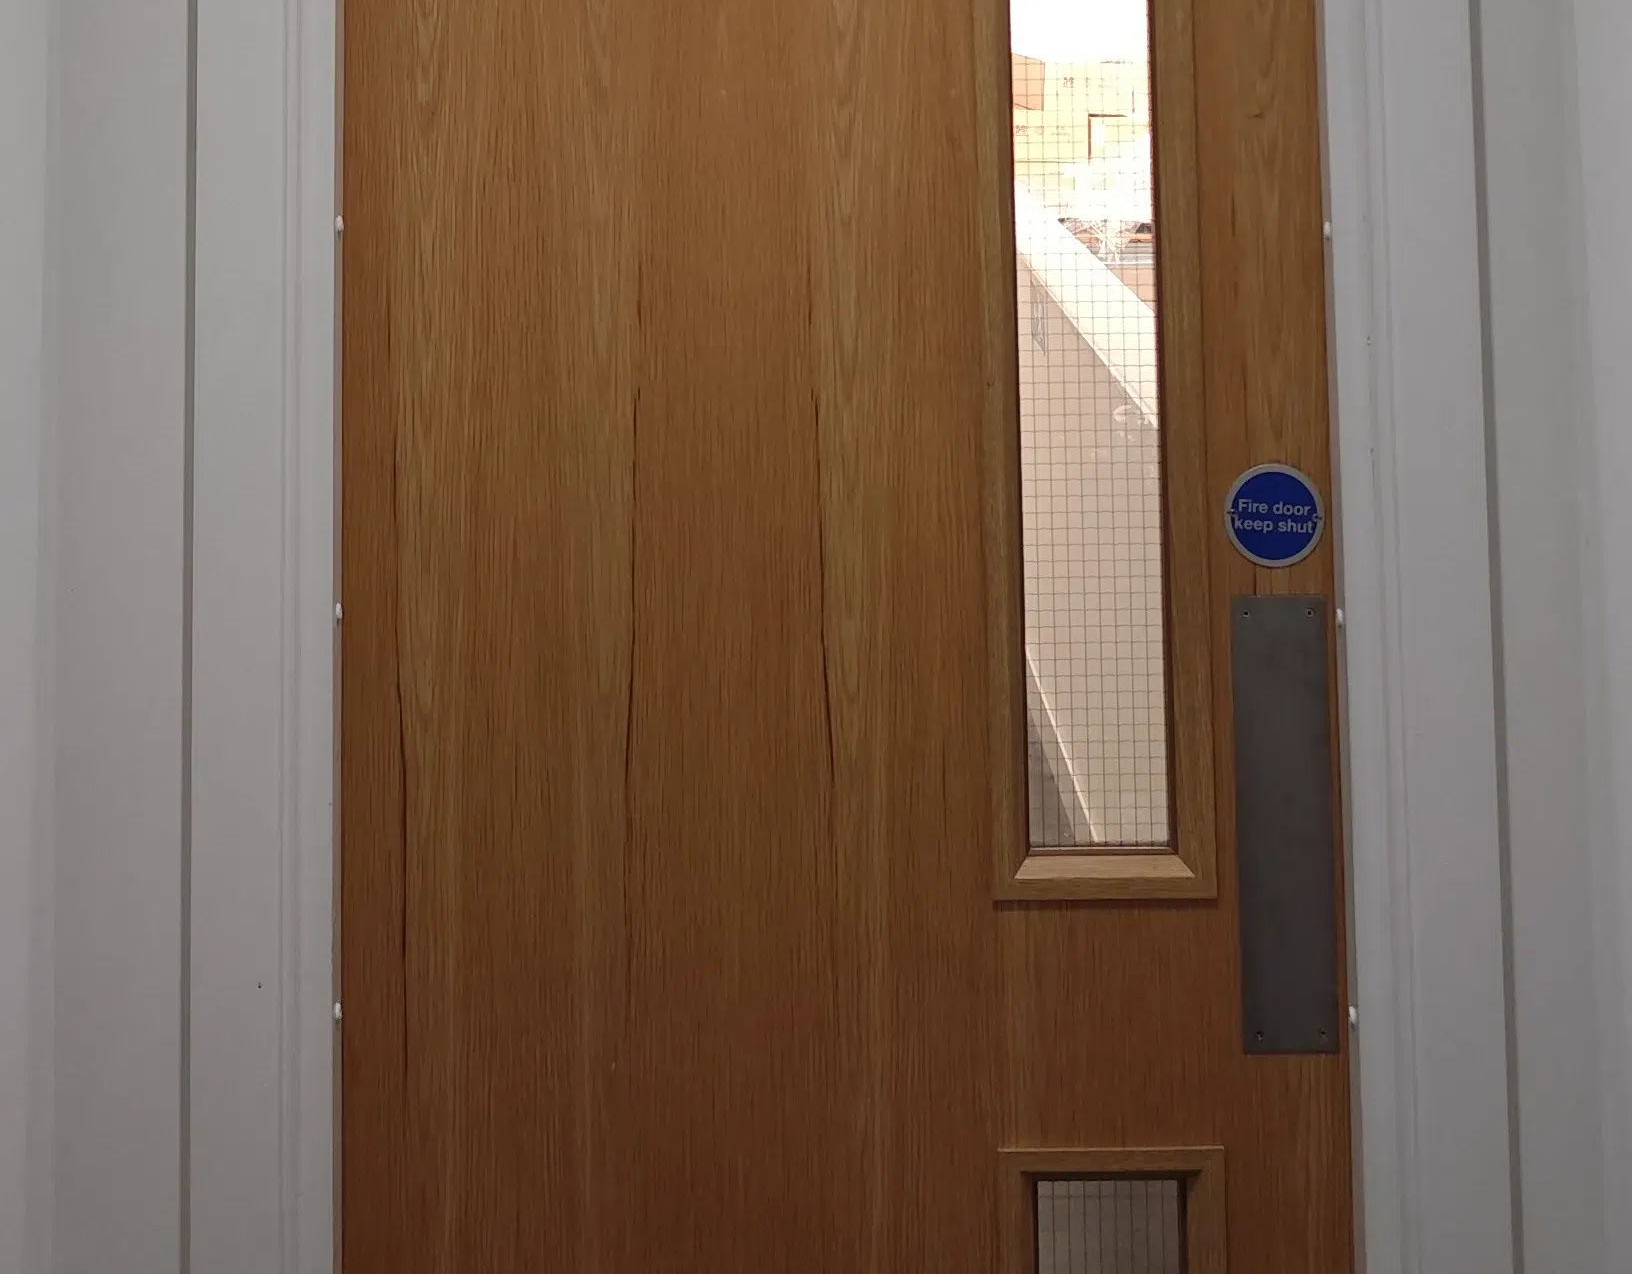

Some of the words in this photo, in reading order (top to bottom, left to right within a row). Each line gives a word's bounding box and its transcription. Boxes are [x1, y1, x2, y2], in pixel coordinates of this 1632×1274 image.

[1238, 498, 1269, 514] Fire
[1273, 501, 1312, 516] door
[1234, 516, 1273, 533] keep
[1277, 519, 1314, 533] shut
